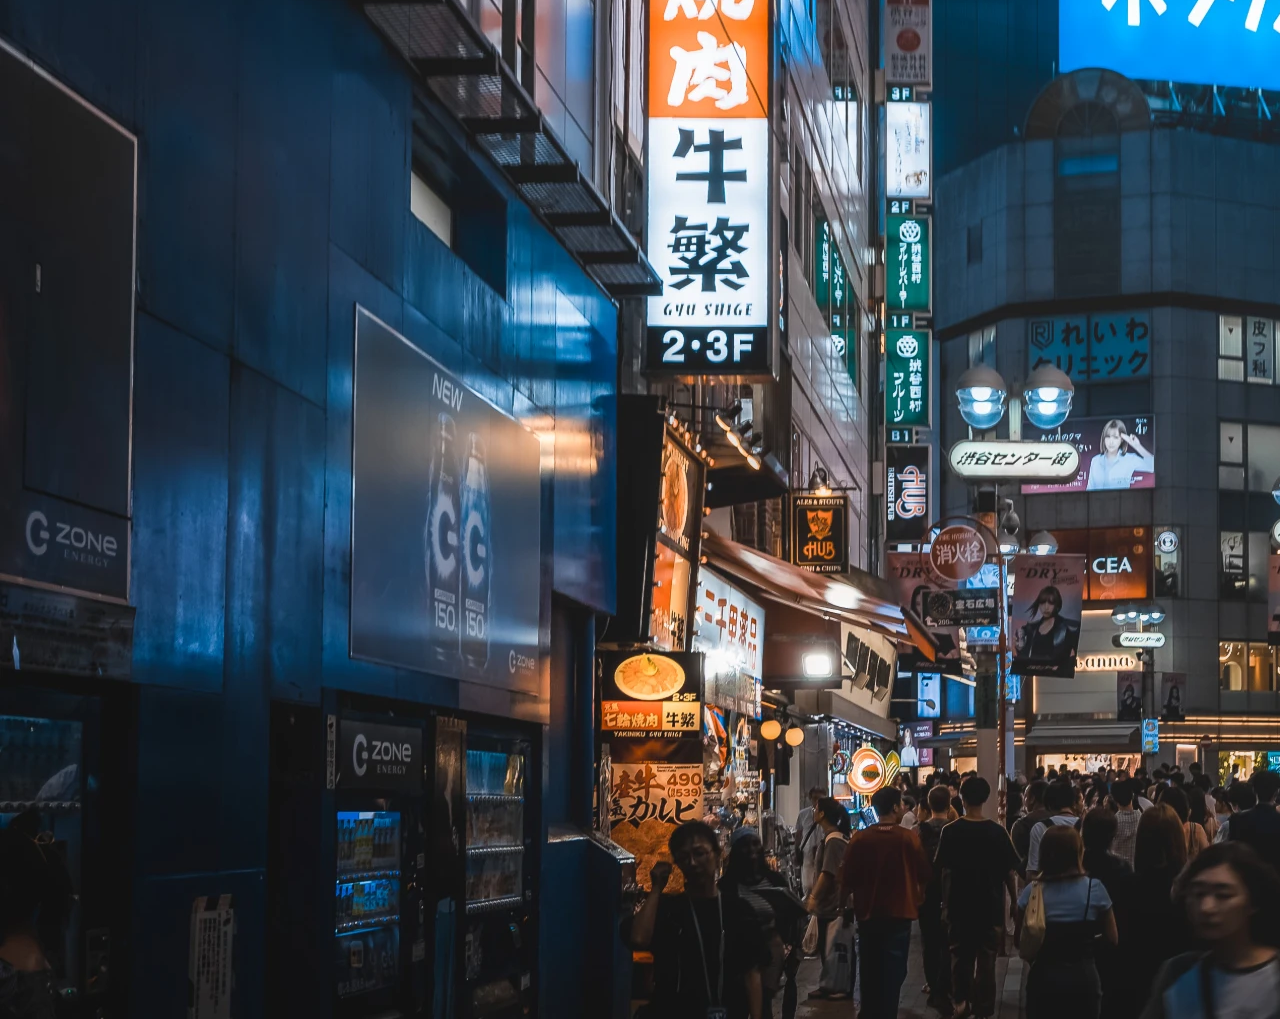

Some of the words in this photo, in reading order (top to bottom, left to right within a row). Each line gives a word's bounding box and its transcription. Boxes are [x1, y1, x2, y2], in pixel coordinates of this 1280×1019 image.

[891, 200, 910, 214] 2F
[891, 315, 910, 328] 1F
[1061, 317, 1149, 347] れいわ
[1252, 319, 1268, 377] 皮フ科
[431, 372, 464, 413] NEW
[908, 358, 923, 413] 渋谷西村
[892, 372, 906, 423] フルーツ
[891, 430, 909, 442] B1
[957, 451, 1073, 466] 渋谷センター街
[887, 467, 895, 501] BRITISH
[896, 465, 927, 519] HUB
[887, 502, 895, 521] PUB
[63, 548, 109, 569] ENERGY
[803, 540, 836, 560] HUB
[936, 542, 981, 566] 消火栓
[955, 597, 995, 610] 宝石広場
[434, 601, 456, 633] 150
[465, 610, 485, 640] 150
[604, 712, 659, 728] 七輪焼肉
[376, 763, 408, 776] ENERGY
[667, 772, 702, 787] 490
